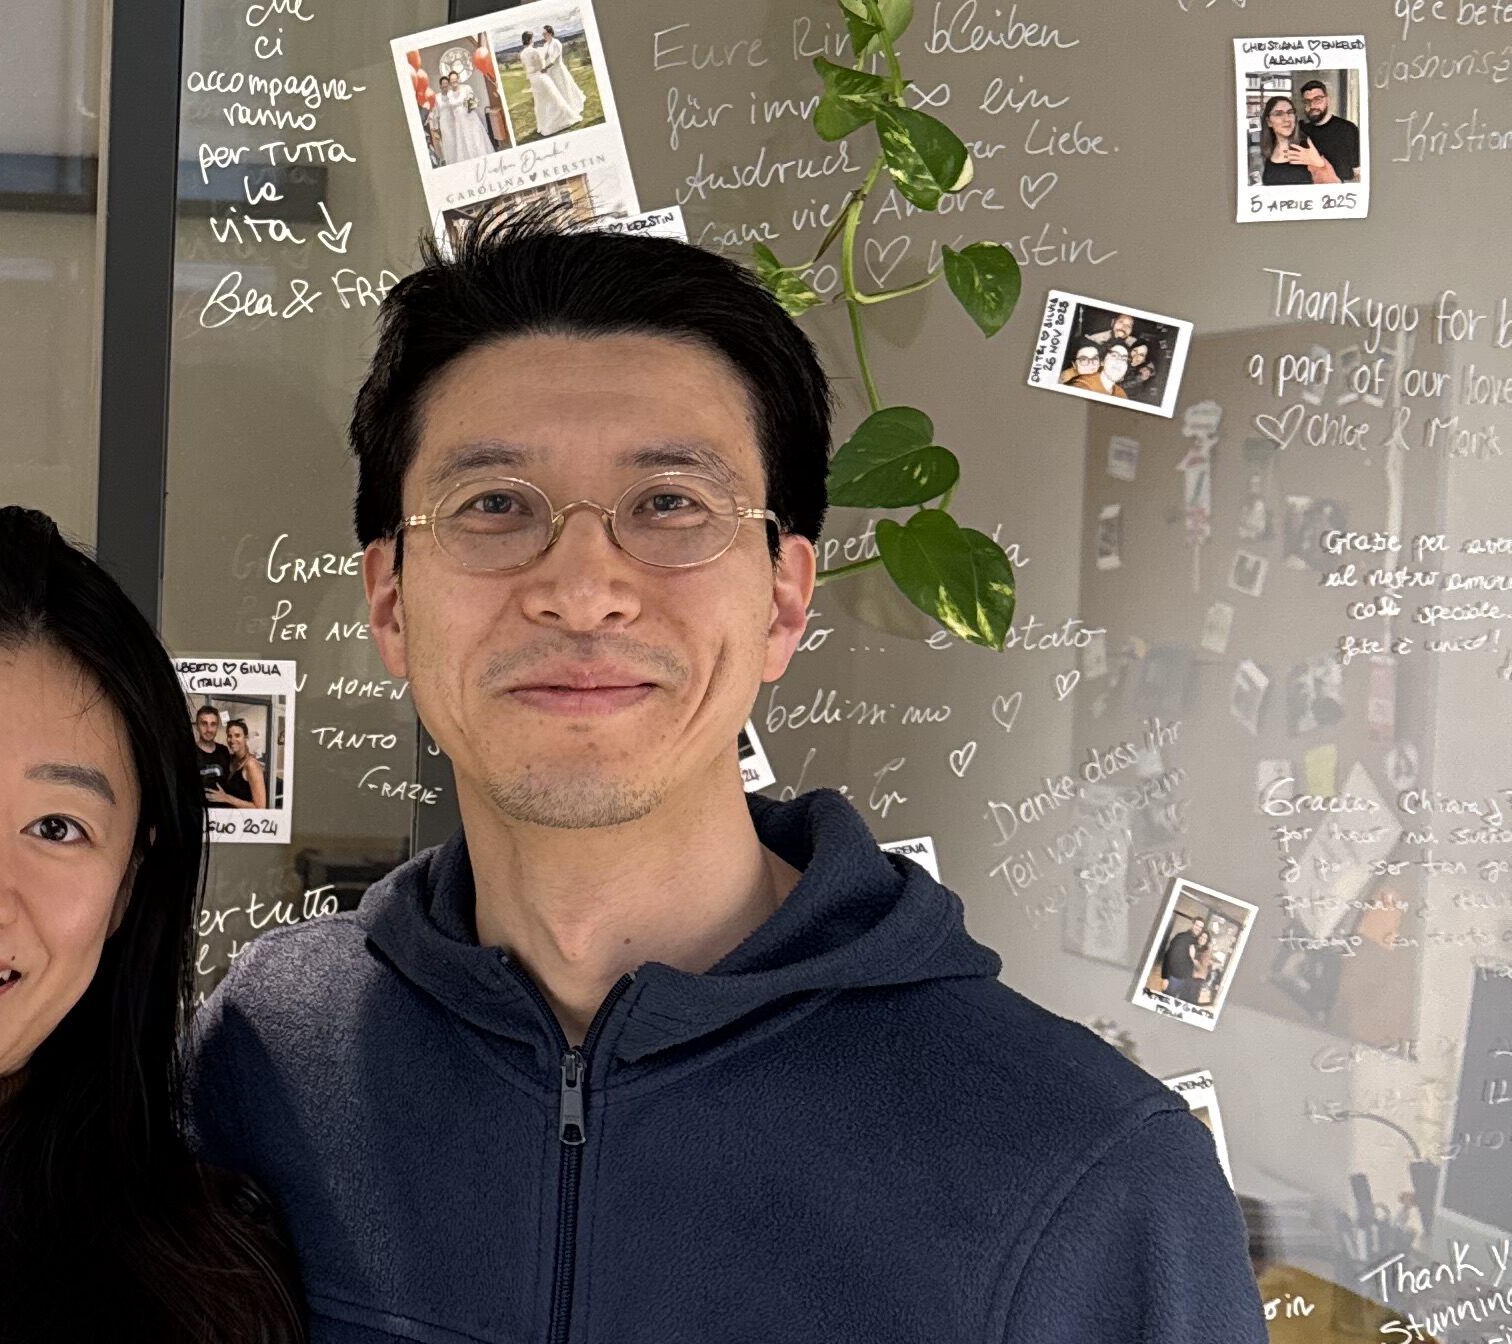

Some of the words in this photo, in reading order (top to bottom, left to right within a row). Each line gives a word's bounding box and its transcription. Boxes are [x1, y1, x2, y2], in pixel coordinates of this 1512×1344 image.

[255, 28, 283, 59] ci
[667, 86, 733, 150] für
[198, 143, 250, 184] per
[446, 178, 525, 204] CAROLINA
[542, 153, 606, 178] KERSTIN
[1251, 194, 1262, 213] 5
[1268, 199, 1313, 212] APRILE
[1321, 193, 1357, 209] 2025
[283, 279, 321, 319] &
[1435, 290, 1486, 344] for
[1049, 329, 1062, 353] NOV
[1278, 353, 1334, 396] part
[1353, 360, 1384, 395] of
[1405, 369, 1451, 396] our
[326, 620, 370, 642] AVE
[189, 676, 237, 690] (ITALIA)
[240, 663, 281, 676] GIULIA
[327, 677, 410, 702] MOMEN
[312, 727, 397, 750] TANTO
[1085, 743, 1137, 783] dass
[243, 819, 278, 836] 2024
[1360, 1241, 1484, 1302] Thank
